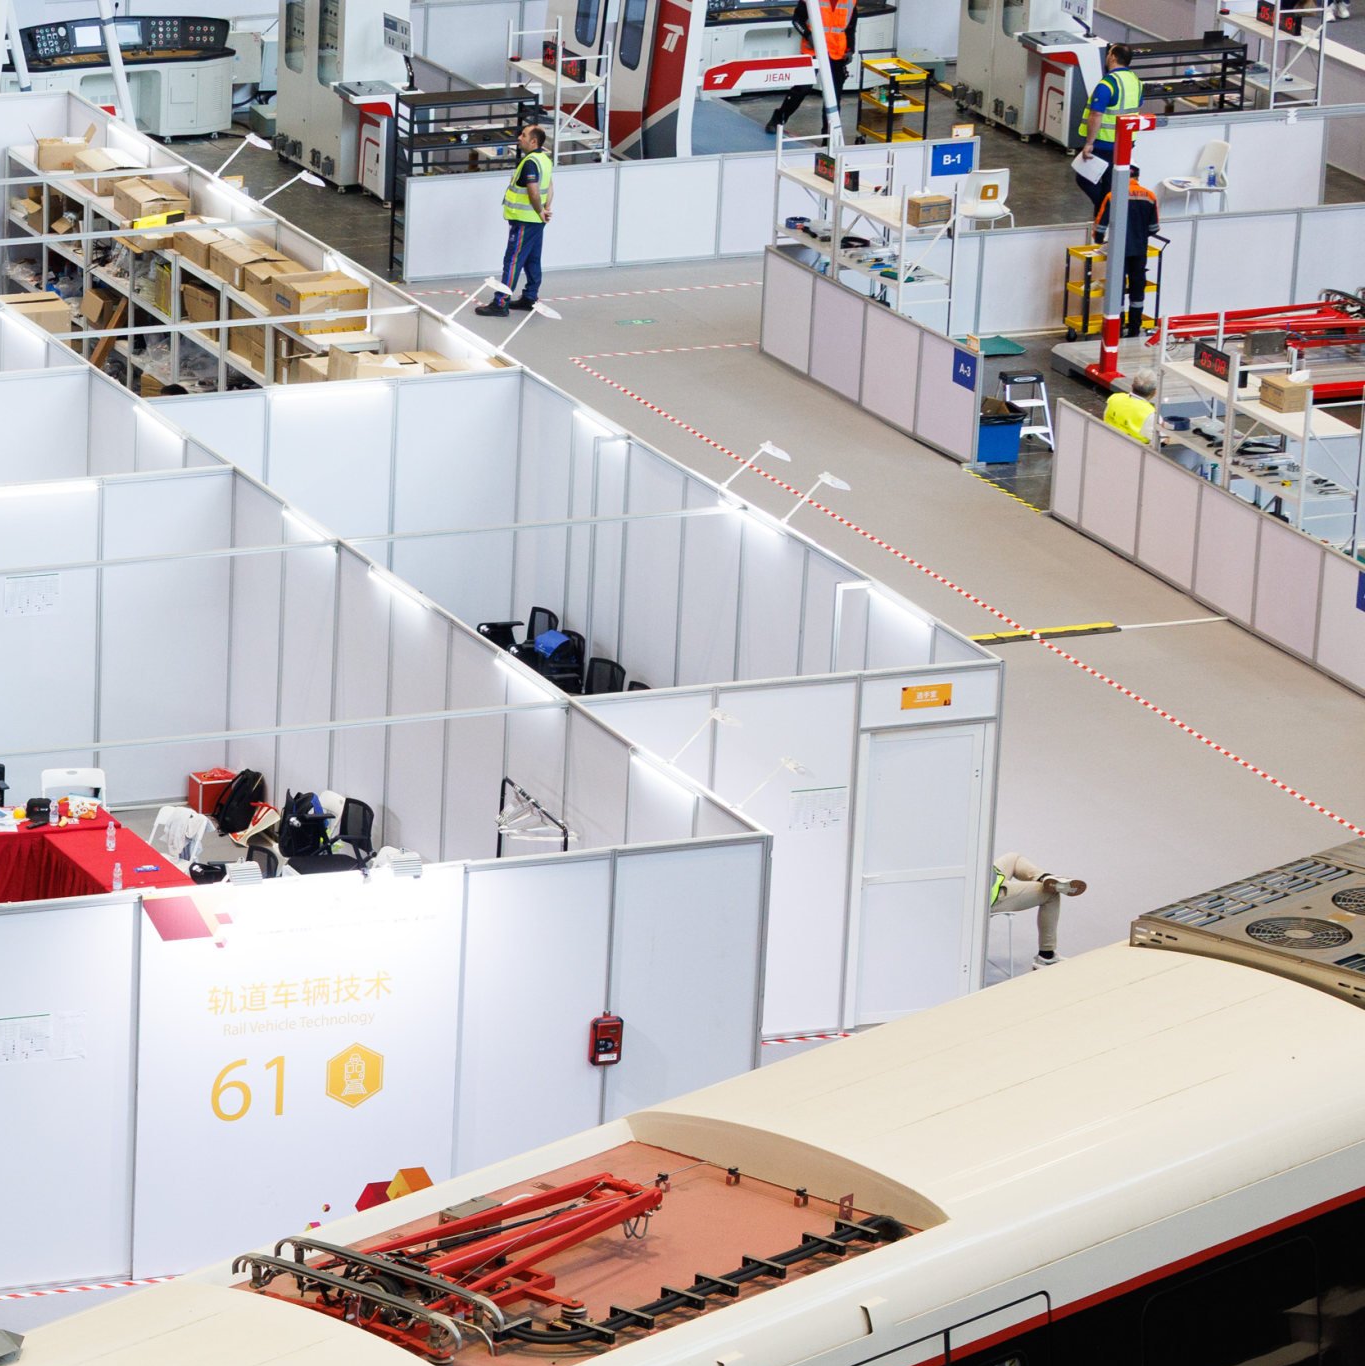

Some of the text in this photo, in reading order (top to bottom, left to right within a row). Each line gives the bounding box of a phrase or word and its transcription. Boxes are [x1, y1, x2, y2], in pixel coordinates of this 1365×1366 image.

[764, 72, 791, 83] JIEAN
[942, 153, 962, 166] B-1
[959, 362, 971, 377] A-3
[207, 970, 393, 1016] 轨道车辆技术
[223, 1011, 375, 1037] Rail Vehicle Technology
[210, 1055, 285, 1122] 61
